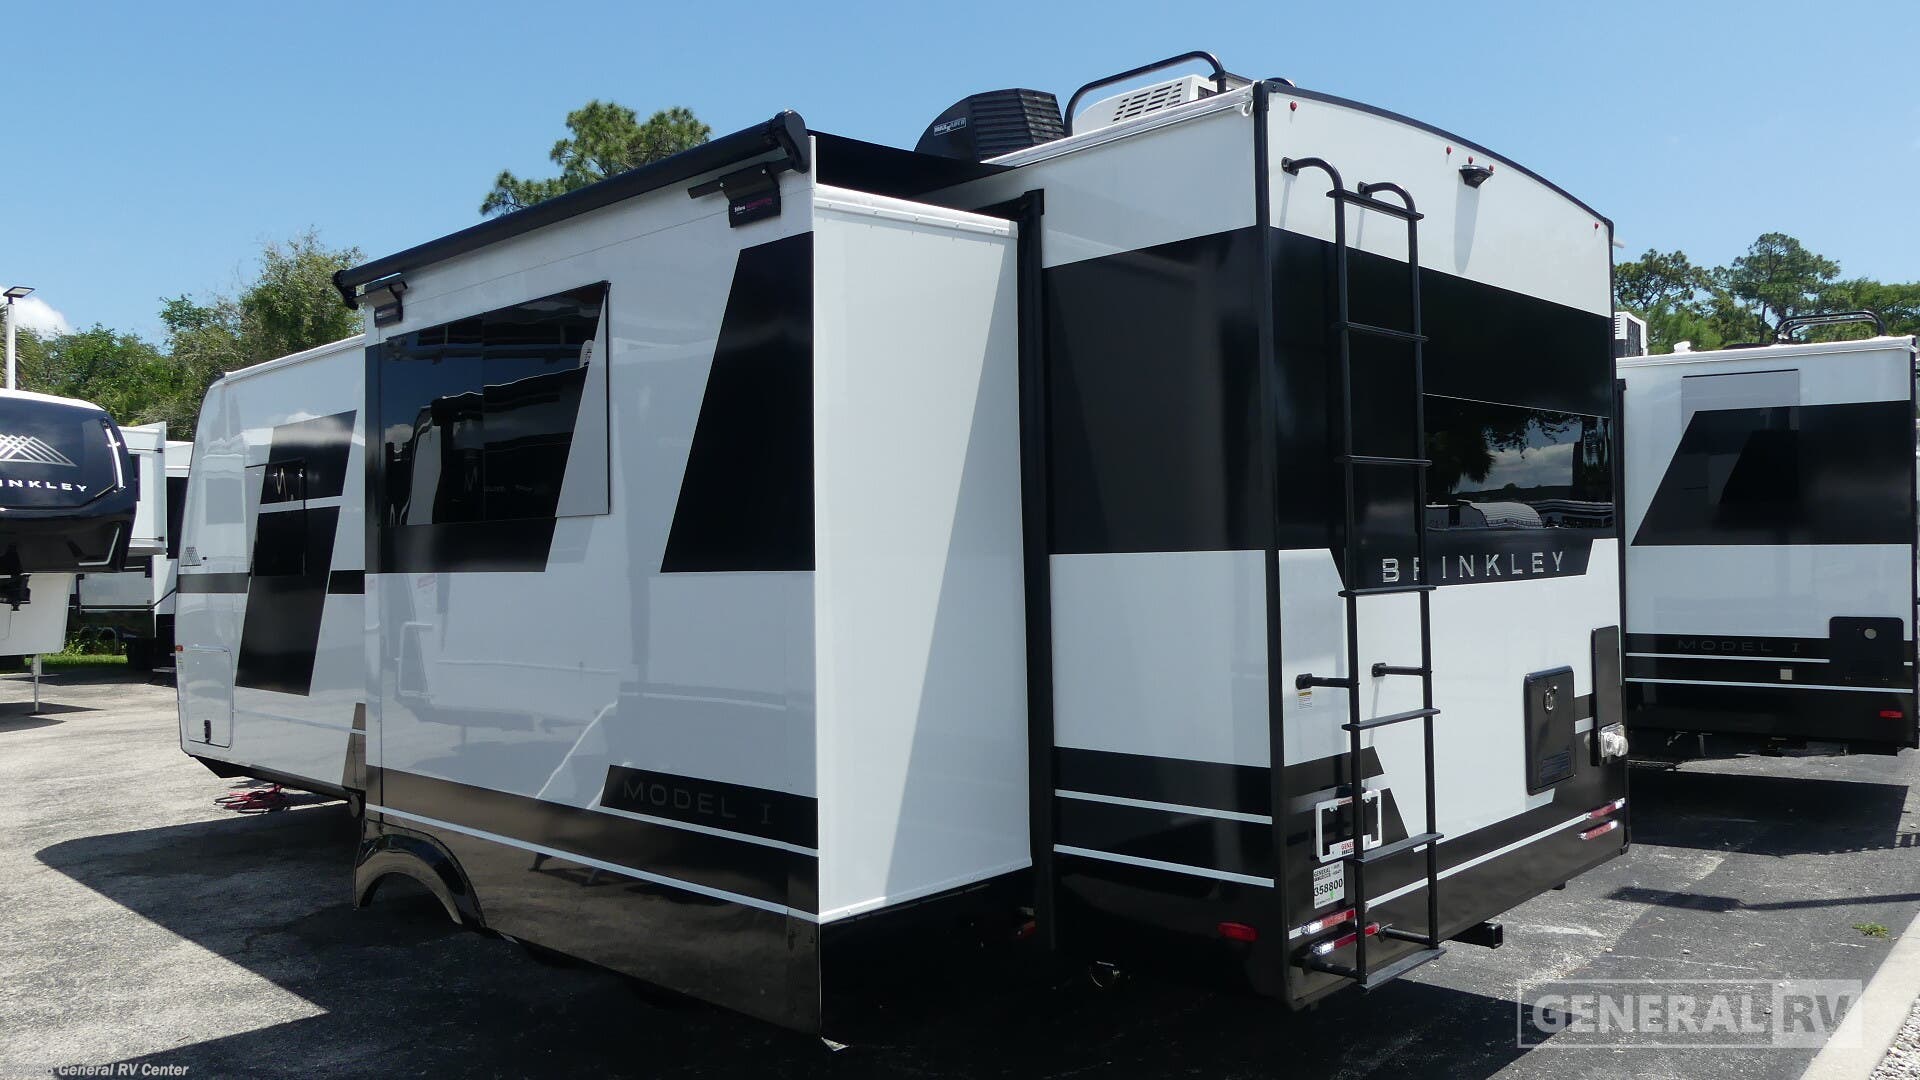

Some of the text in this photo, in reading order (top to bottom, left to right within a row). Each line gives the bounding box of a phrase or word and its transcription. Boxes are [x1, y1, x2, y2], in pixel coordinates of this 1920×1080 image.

[1678, 639, 1773, 652] MODEL
[623, 780, 776, 825] MODEL I
[1314, 879, 1343, 897] 358800
